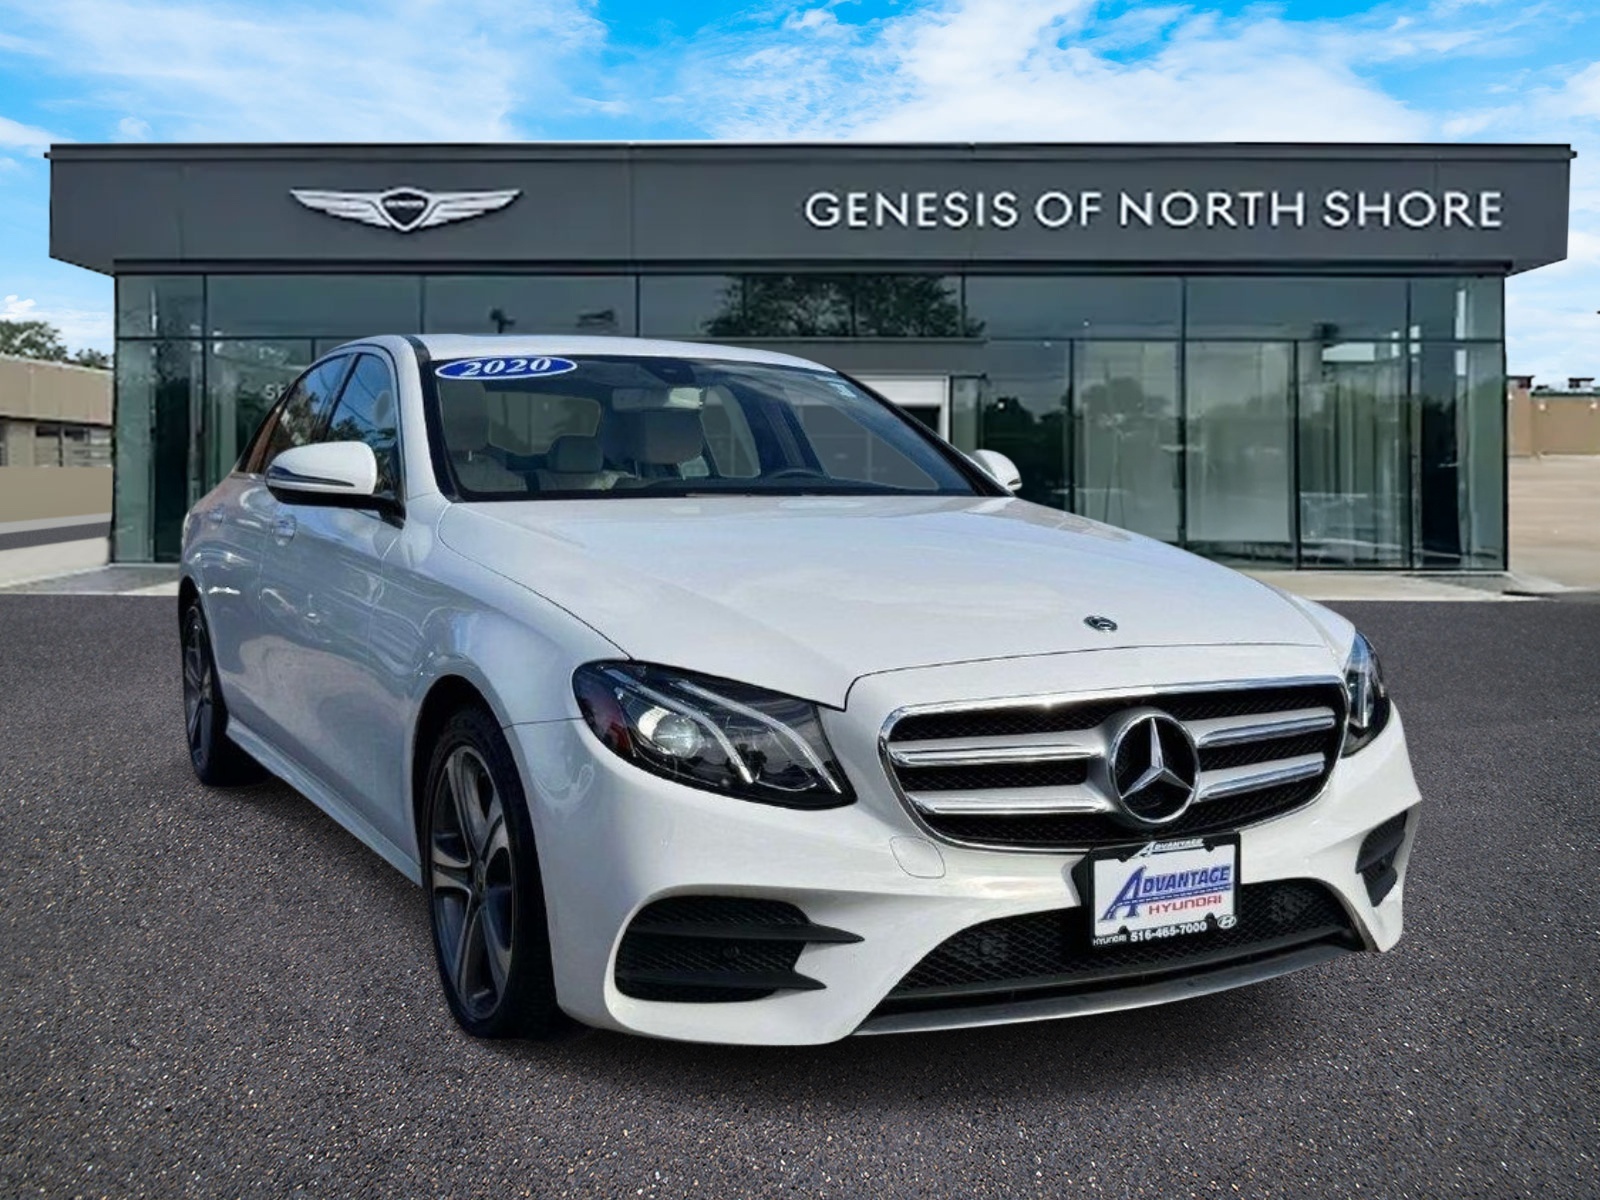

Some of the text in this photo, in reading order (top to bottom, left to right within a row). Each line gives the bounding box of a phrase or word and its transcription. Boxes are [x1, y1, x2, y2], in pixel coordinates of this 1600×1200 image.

[805, 190, 1503, 228] GENESIS OF NORTH SHORE
[460, 358, 551, 376] 2020
[1098, 864, 1231, 922] ADVANTAGE
[1149, 894, 1222, 916] HYUNDAI
